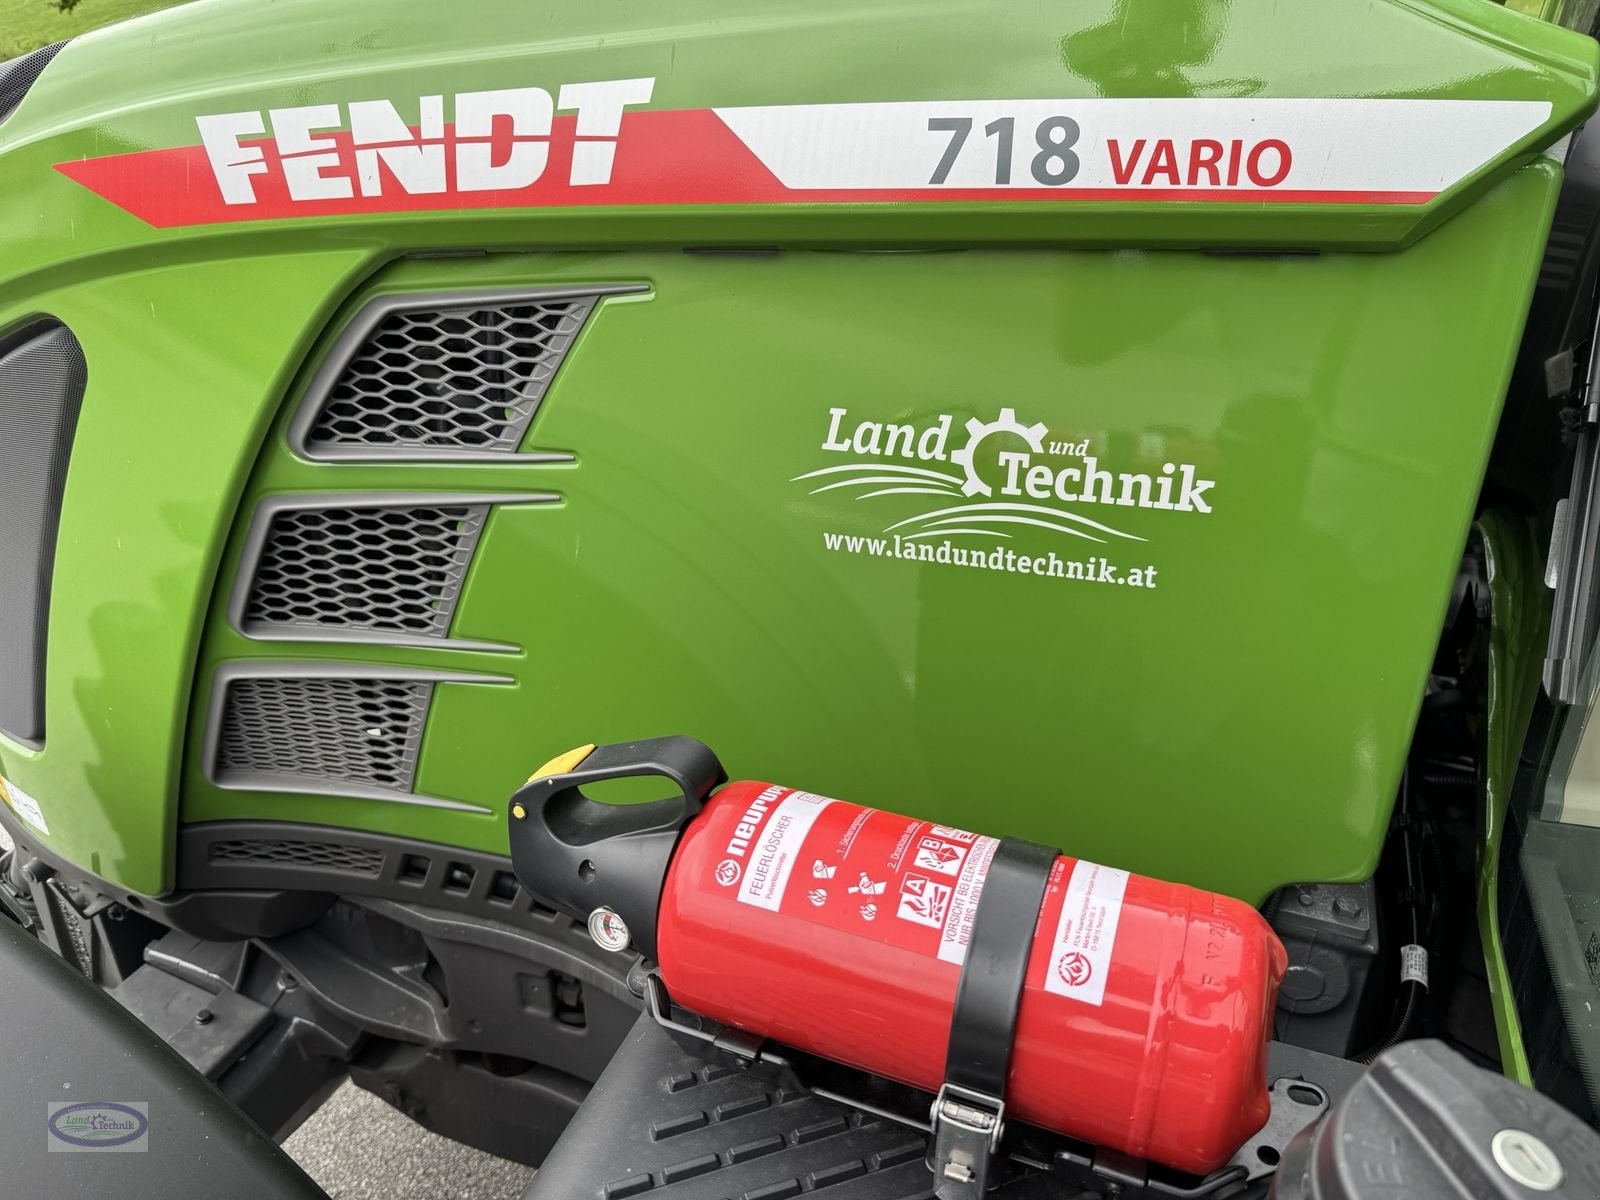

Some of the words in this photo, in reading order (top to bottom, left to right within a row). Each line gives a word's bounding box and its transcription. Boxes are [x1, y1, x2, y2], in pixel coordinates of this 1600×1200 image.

[195, 77, 656, 205] FENDT
[927, 115, 1080, 186] 718
[1106, 139, 1293, 187] VARIO
[821, 407, 953, 461] Land
[1048, 439, 1089, 457] und
[998, 451, 1216, 513] Technik
[823, 532, 1158, 589] www.landundtechnik.at
[749, 815, 793, 897] FEUERLÖSCHER
[922, 838, 940, 850] B
[905, 879, 926, 896] A
[944, 896, 965, 943] VORSICHT
[958, 882, 970, 896] BEI
